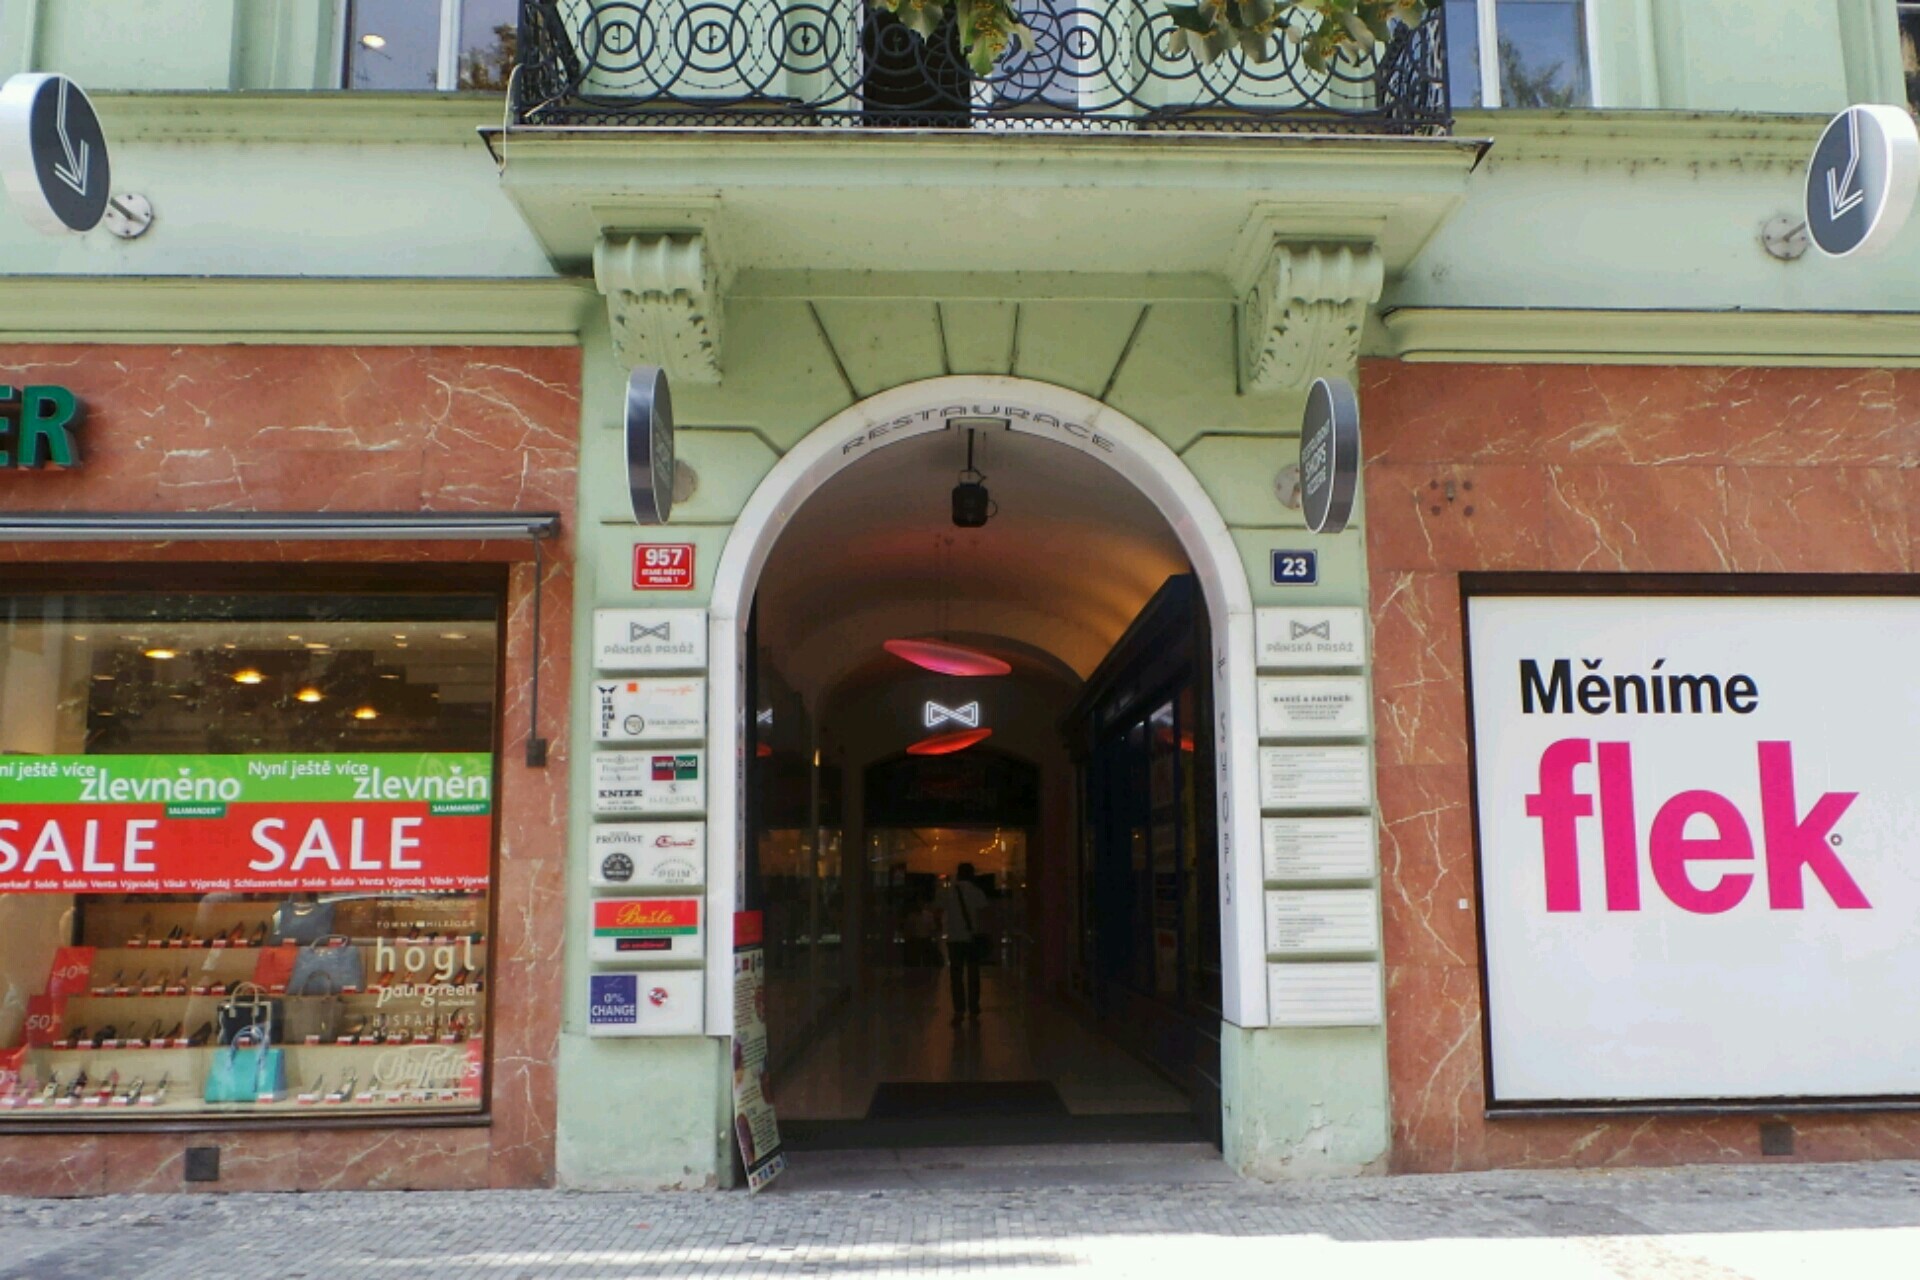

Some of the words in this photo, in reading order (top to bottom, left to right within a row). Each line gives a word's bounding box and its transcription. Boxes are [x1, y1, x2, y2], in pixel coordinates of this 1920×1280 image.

[842, 405, 1116, 454] RESTAURACE
[645, 549, 682, 566] 957
[1282, 558, 1307, 576] 23
[1519, 658, 1758, 715] Měníme
[16, 762, 58, 781] ještě
[63, 762, 95, 777] více
[79, 768, 241, 801] zlevněno
[248, 760, 287, 780] Nyní
[290, 760, 331, 779] ještě
[336, 760, 368, 775] více
[353, 765, 488, 799] zlevněn
[1525, 737, 1873, 914] flek
[0, 819, 158, 873] SALE
[249, 817, 423, 872] SALE
[376, 985, 418, 1008] paul
[420, 983, 478, 1007] green
[592, 1005, 635, 1016] CHANGE
